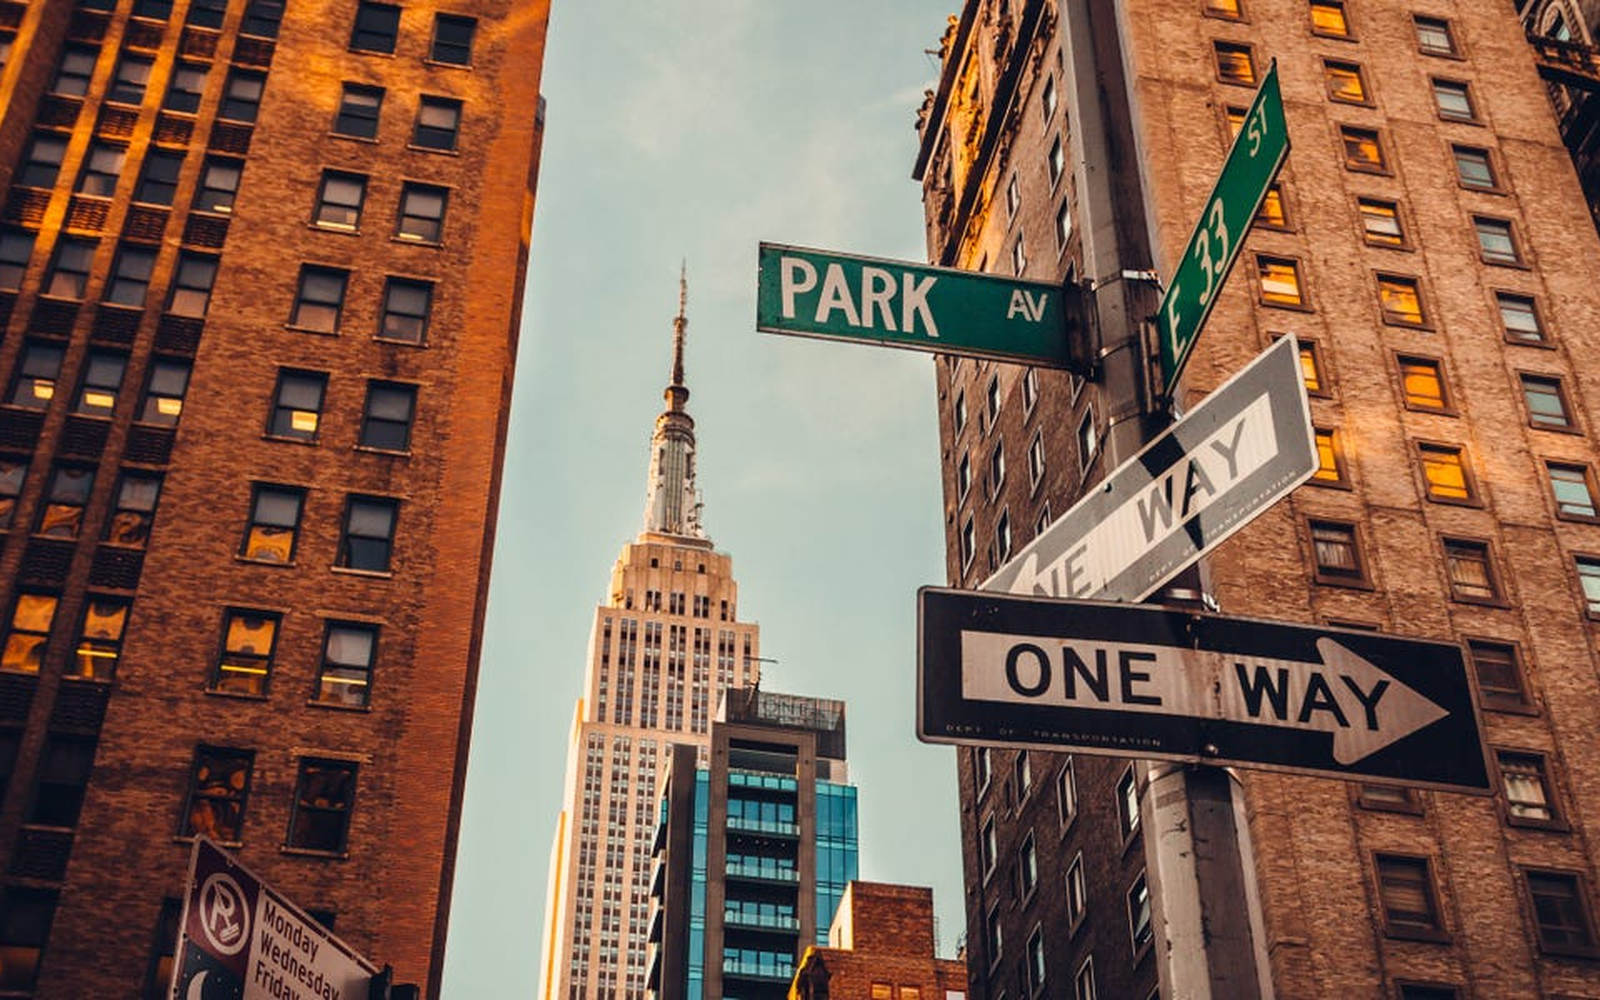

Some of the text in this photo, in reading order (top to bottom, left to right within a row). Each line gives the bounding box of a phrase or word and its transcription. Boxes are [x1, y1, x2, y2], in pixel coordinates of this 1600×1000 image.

[1168, 95, 1268, 364] E 33 ST
[780, 256, 1048, 337] PARK AV
[1033, 417, 1247, 598] NE WAY
[1005, 643, 1391, 732] ONE WAY
[261, 929, 340, 1000] Wednesday
[263, 901, 319, 963] Monday
